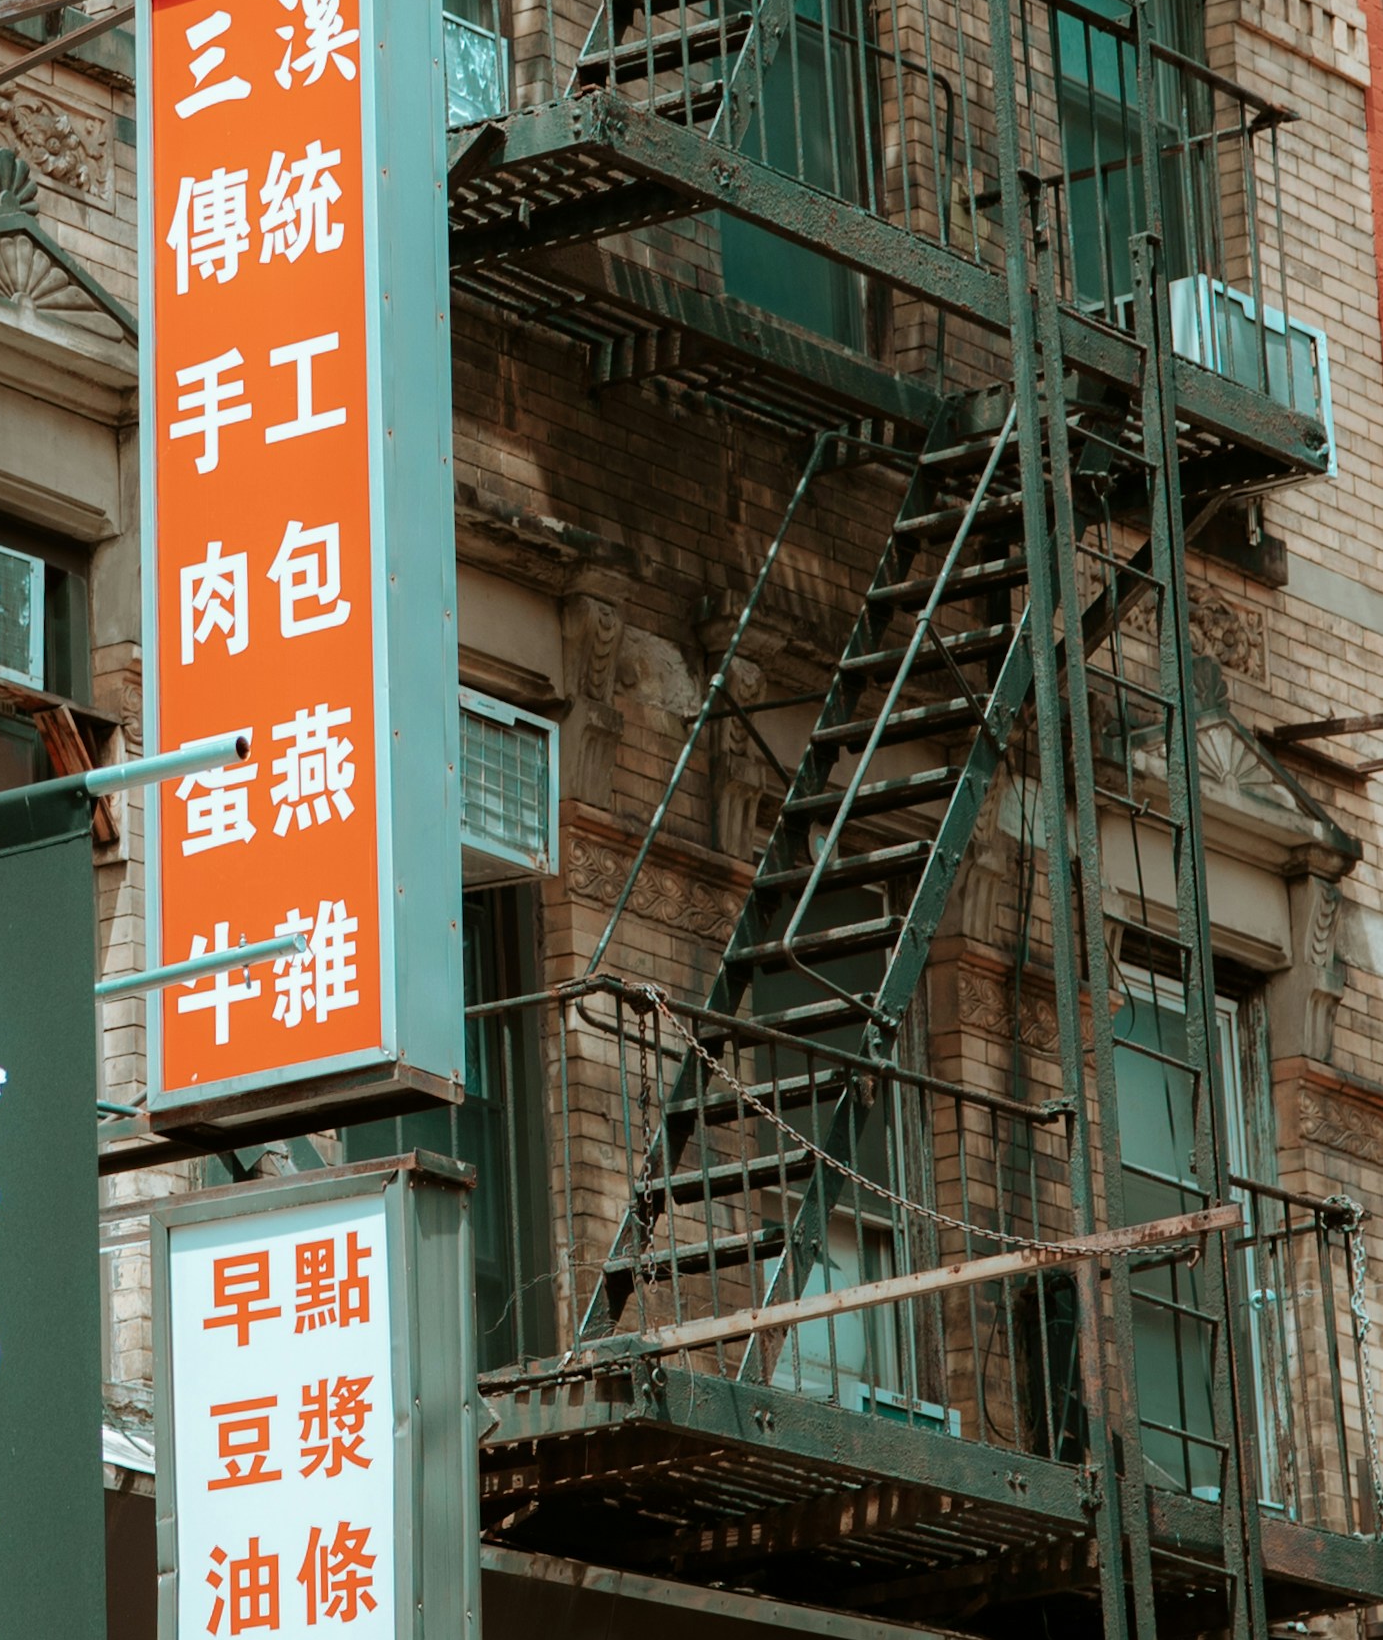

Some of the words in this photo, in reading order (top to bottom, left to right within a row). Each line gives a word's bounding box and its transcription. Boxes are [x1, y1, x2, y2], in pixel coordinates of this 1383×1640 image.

[166, 140, 345, 295] 傳統
[169, 331, 347, 475] 手工
[180, 520, 352, 666] 肉包
[175, 703, 356, 857] 蛋燕
[177, 899, 360, 1045] 牛雜
[203, 1231, 372, 1347] 早點
[207, 1375, 374, 1491] 豆漿
[205, 1520, 378, 1636] 油條
